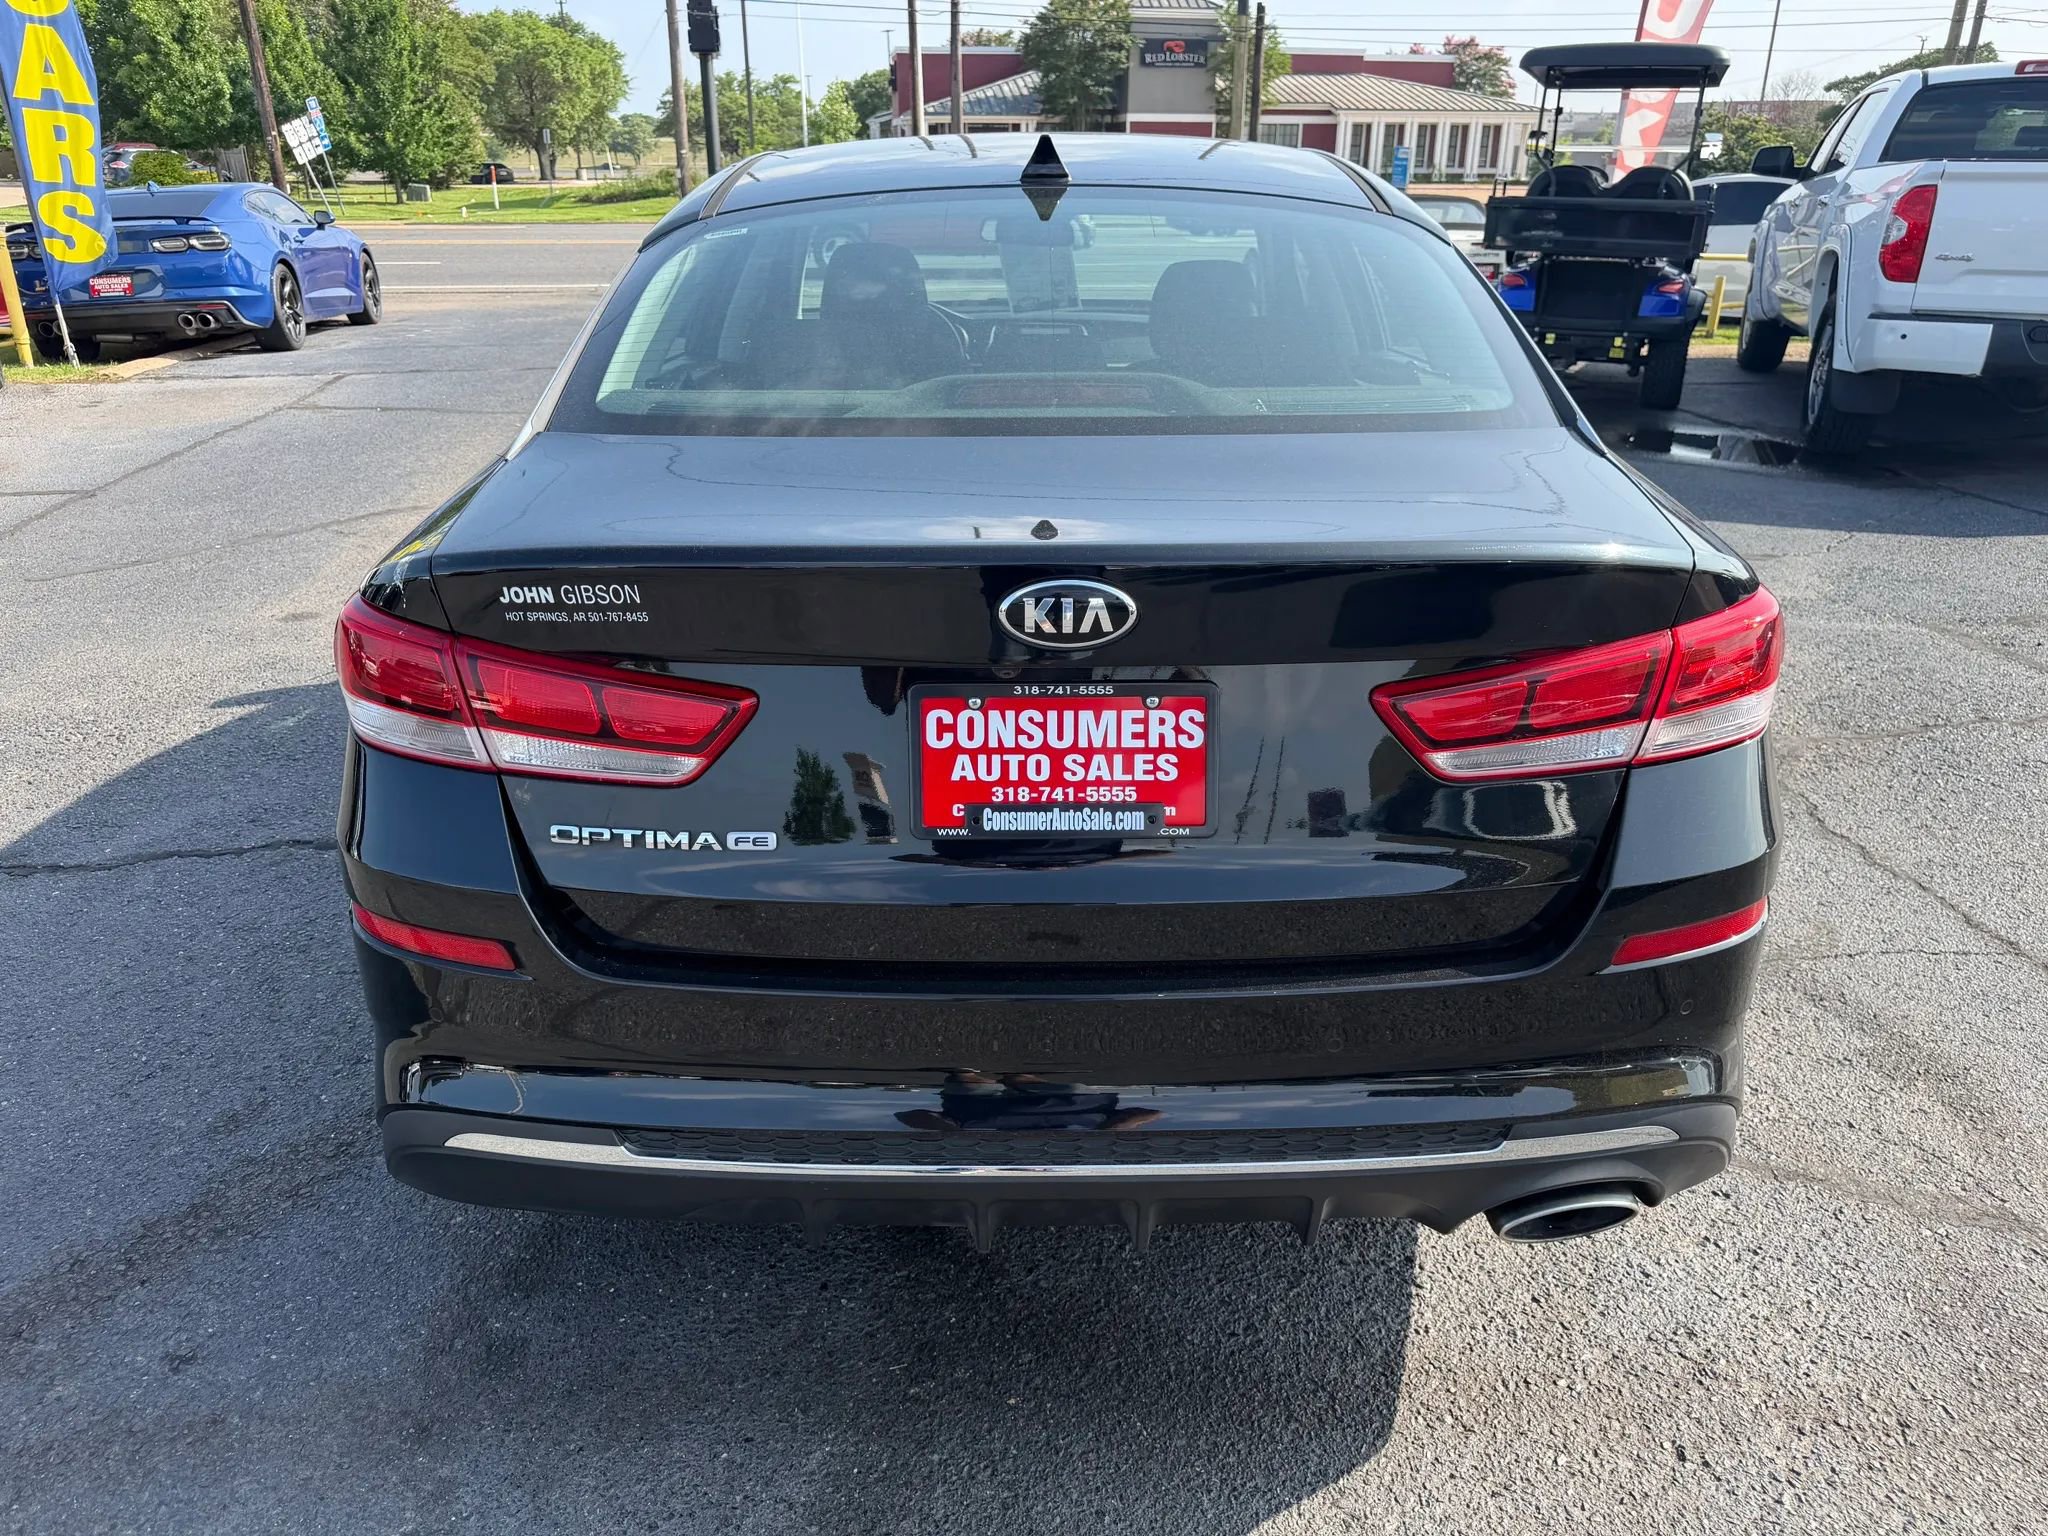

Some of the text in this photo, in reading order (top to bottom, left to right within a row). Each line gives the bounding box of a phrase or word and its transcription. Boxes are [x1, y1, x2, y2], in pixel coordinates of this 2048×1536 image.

[1144, 51, 1207, 64] RED LOBSTER
[6, 0, 108, 264] ARS
[89, 276, 132, 285] CONSUMERS
[499, 584, 641, 605] JOHN GIBSON
[505, 612, 649, 623] HOT SPRINGS, AR 501-767-8455
[1022, 597, 1114, 634] KIA
[1013, 685, 1115, 695] 318-741-5555
[925, 708, 1206, 749] CONSUMERS
[950, 753, 1180, 782] AUTO SALES
[991, 786, 1138, 803] 318-741-5555
[982, 807, 1146, 832] ConsumerAutoSale.com
[549, 823, 770, 851] OPTIMA FE
